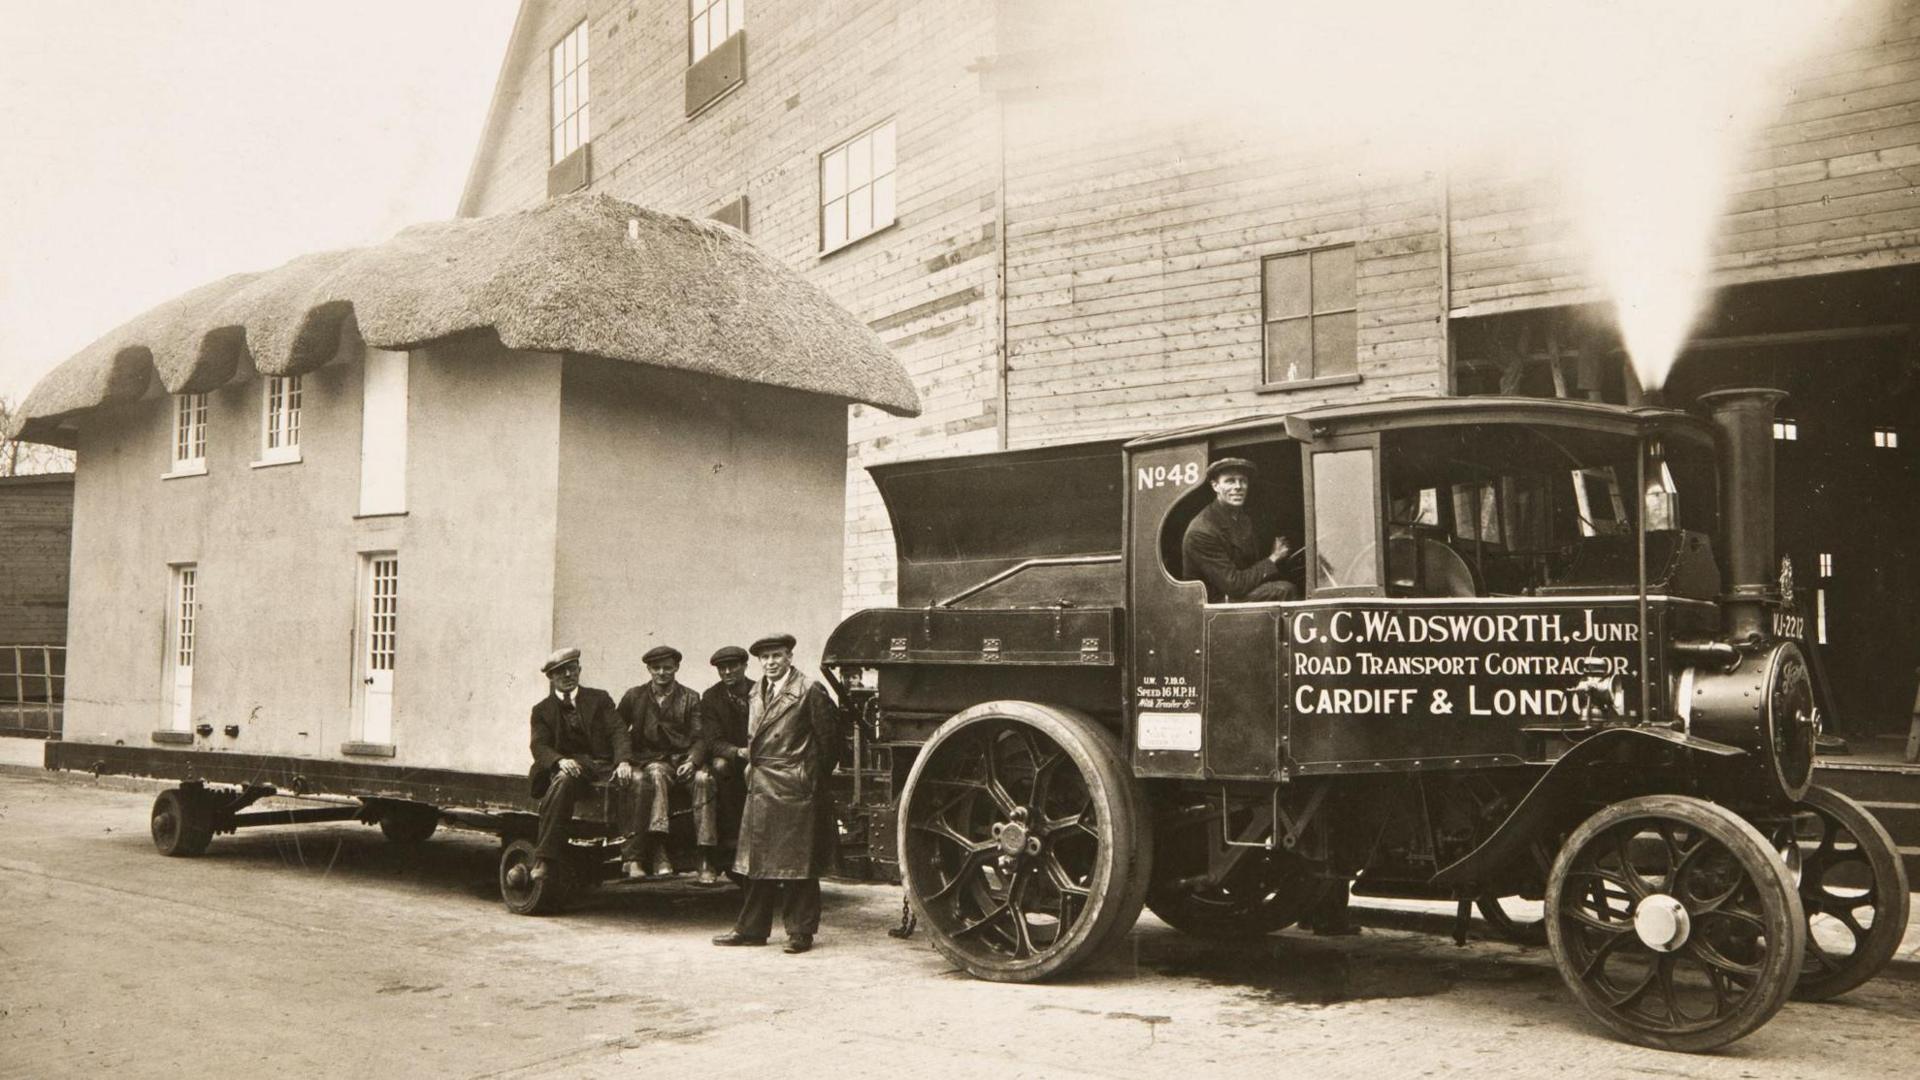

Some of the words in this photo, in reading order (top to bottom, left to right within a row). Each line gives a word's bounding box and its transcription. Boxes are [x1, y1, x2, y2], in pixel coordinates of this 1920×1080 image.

[1294, 652, 1352, 676] ROAD
[1356, 652, 1480, 676] TRANSPORT
[1136, 686, 1161, 697] SPEED
[1162, 686, 1172, 697] 16
[1295, 684, 1418, 715] CARDIFF
[1429, 688, 1454, 715] &
